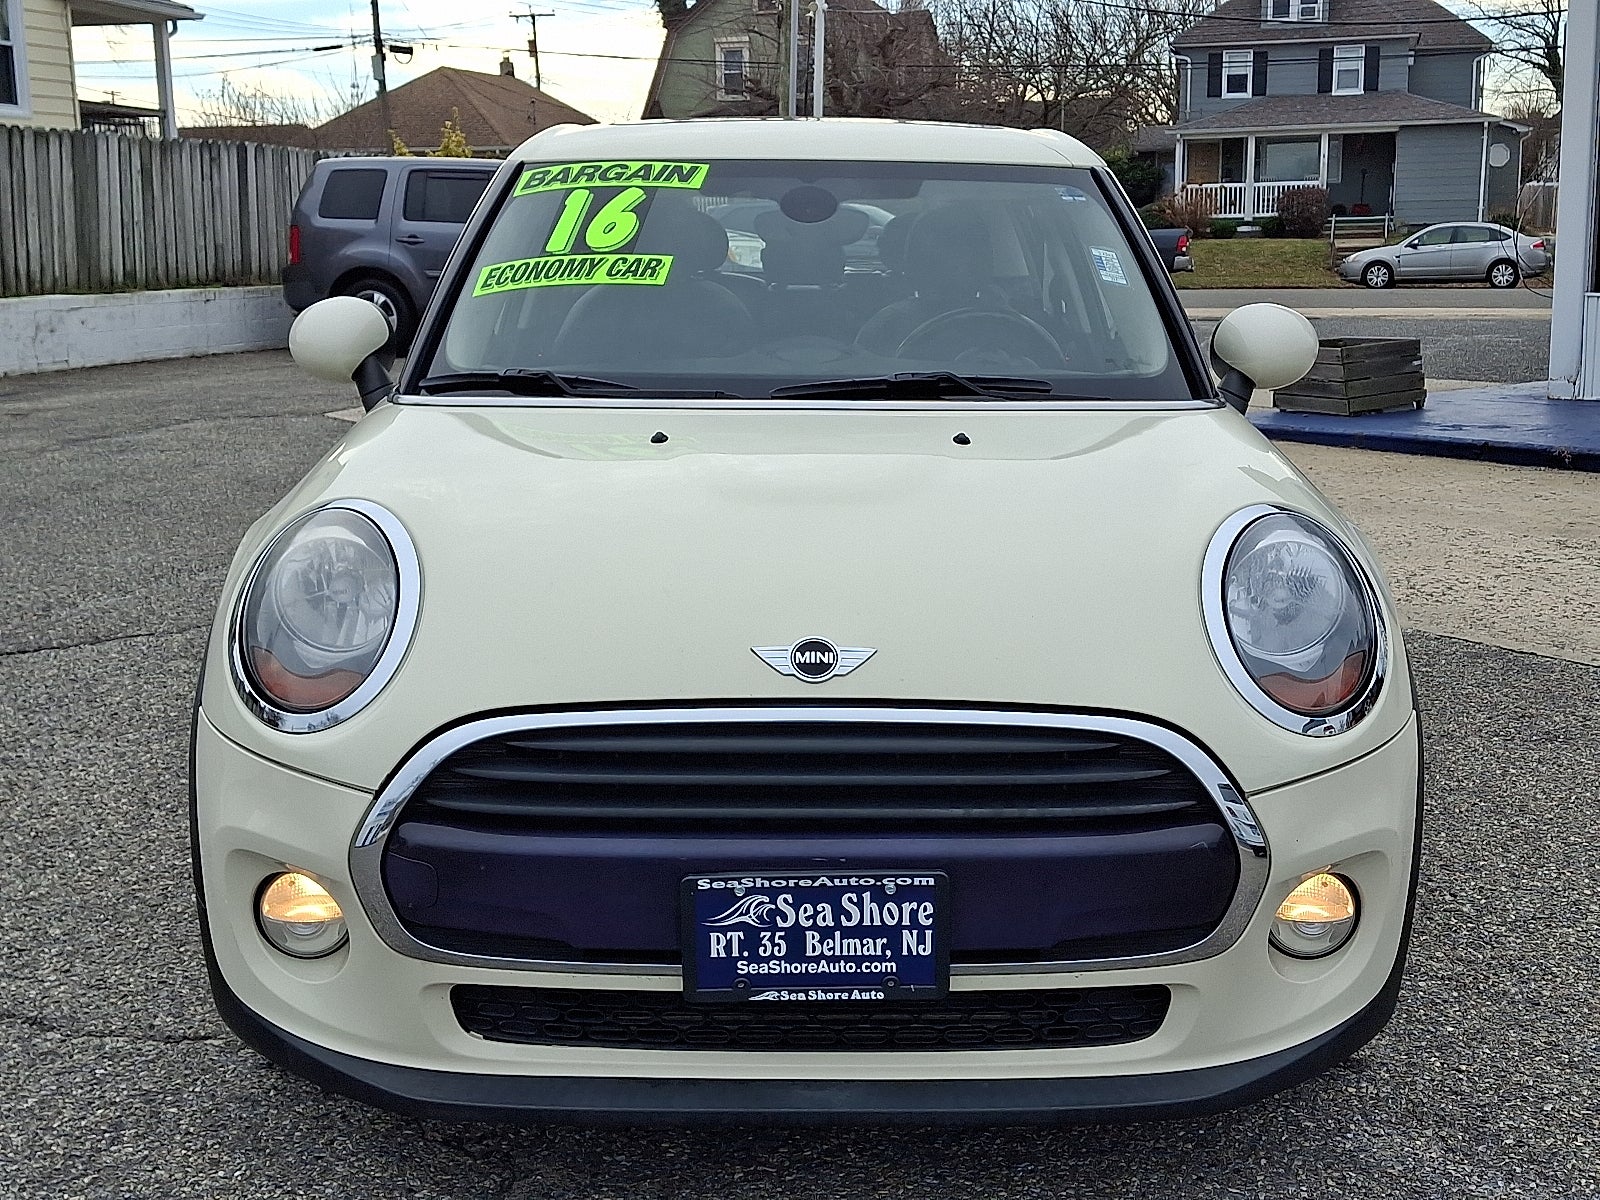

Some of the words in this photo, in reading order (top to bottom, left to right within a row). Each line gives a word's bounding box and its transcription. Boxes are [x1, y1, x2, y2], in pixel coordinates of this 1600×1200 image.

[521, 163, 703, 191] BARGAIN
[545, 186, 647, 254] 16
[480, 256, 609, 290] ECONOMY
[605, 256, 666, 280] CAR
[795, 651, 834, 664] MINI
[697, 876, 935, 890] SeaShoreAuto.com
[776, 893, 834, 928] Sea
[841, 891, 934, 927] Shore
[709, 931, 749, 958] RT.
[758, 931, 787, 957] 35
[805, 930, 892, 959] Belmar,
[901, 929, 933, 956] NJ
[736, 959, 897, 975] SeaShoreAuto.com
[780, 990, 806, 1000] Sea
[808, 990, 849, 1000] Shore
[851, 989, 885, 1000] Auto
